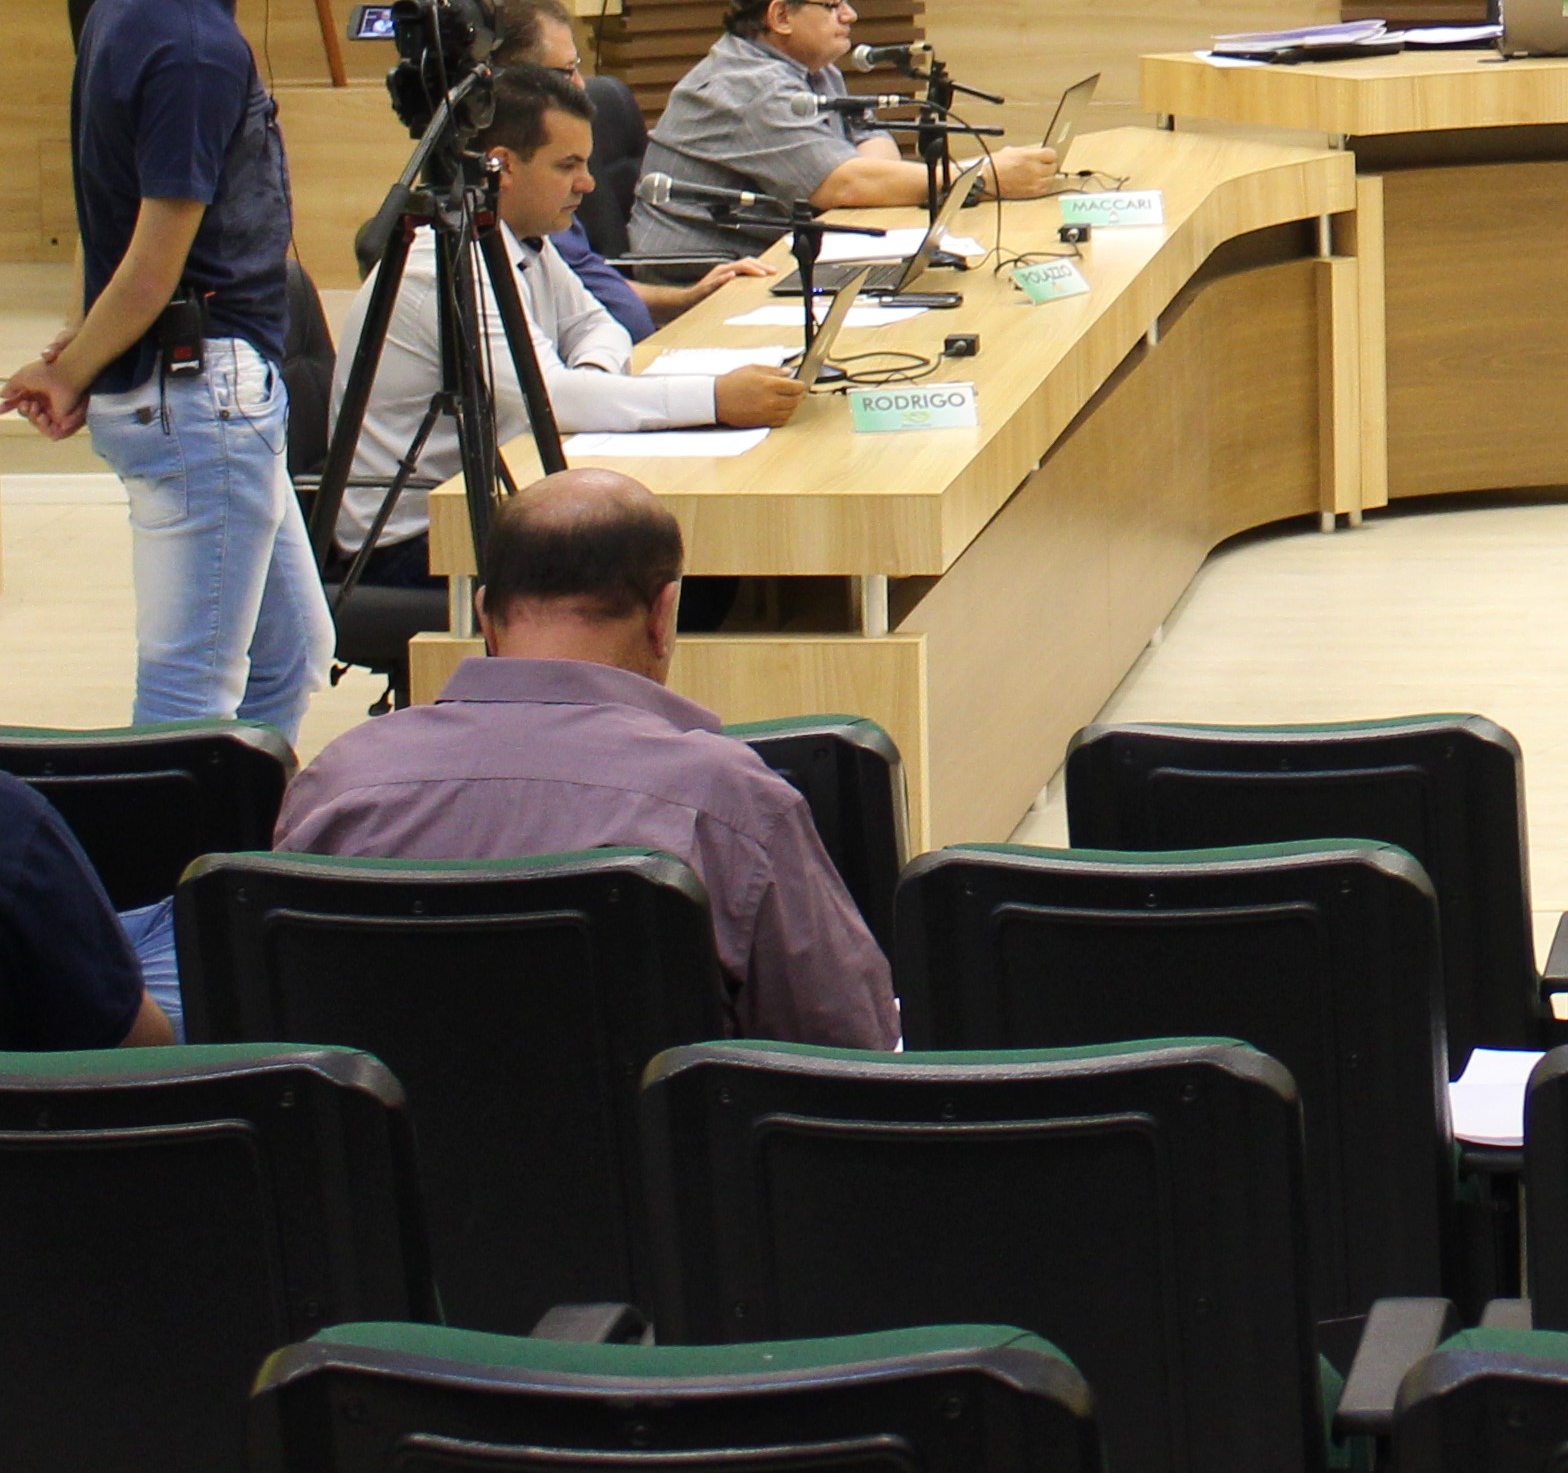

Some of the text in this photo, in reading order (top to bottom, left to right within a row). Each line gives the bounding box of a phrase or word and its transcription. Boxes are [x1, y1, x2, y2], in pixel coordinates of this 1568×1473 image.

[1072, 199, 1152, 212] MACCARI
[1021, 265, 1072, 284] POLAZZO
[862, 392, 966, 412] RODRIGO
